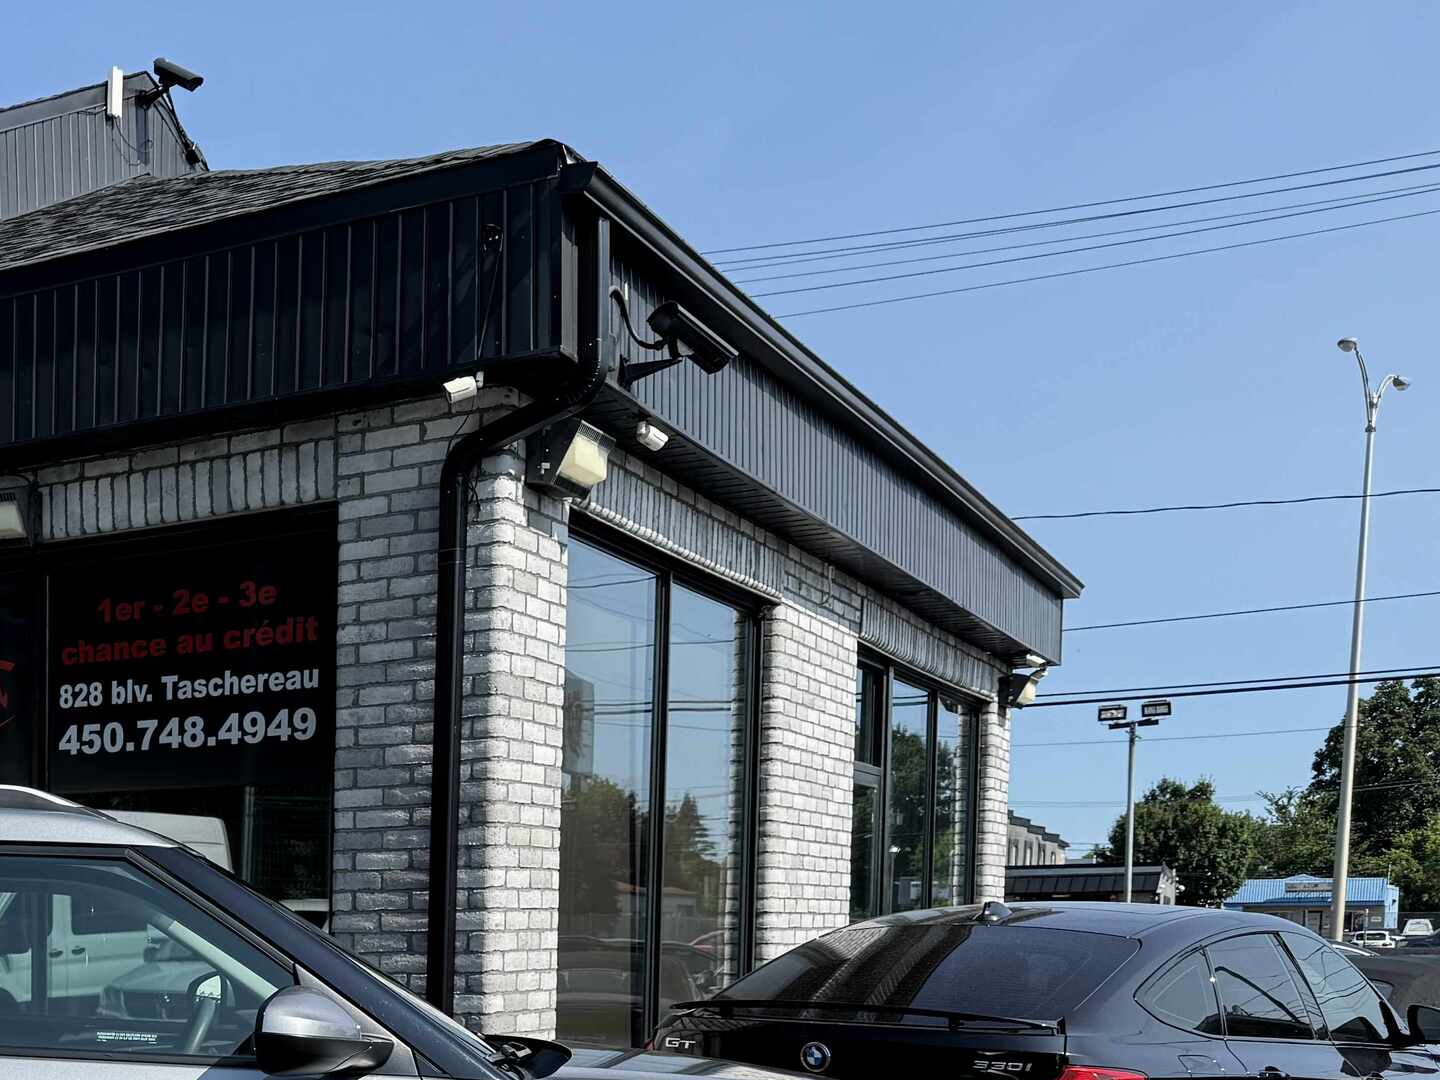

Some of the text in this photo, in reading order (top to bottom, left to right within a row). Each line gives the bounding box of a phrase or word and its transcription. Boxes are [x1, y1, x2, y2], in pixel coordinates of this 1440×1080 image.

[98, 599, 144, 623] 1er
[173, 588, 209, 616] 2e
[240, 580, 277, 609] 3e
[63, 615, 318, 665] chance au crédit
[59, 669, 319, 709] 828 blv. Taschereau
[59, 707, 317, 755] 450.748.4949
[665, 1037, 696, 1049] GT
